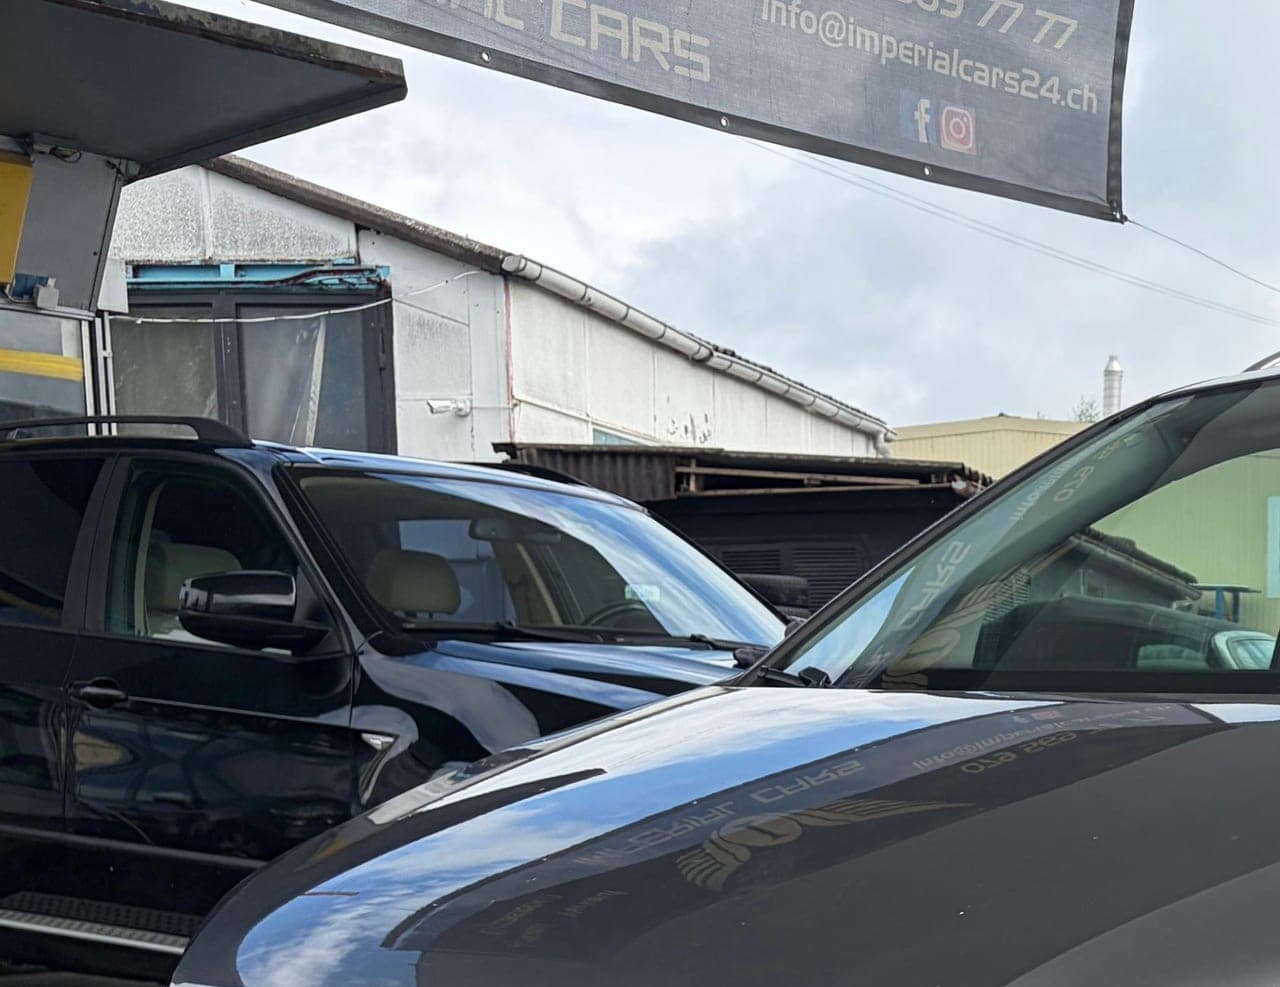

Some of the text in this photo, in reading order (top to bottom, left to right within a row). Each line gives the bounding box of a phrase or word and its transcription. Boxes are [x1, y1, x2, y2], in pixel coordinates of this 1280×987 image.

[549, 0, 711, 82] CARS
[760, 0, 1099, 115] info@imperialcars24.ch
[1032, 8, 1079, 50] 77
